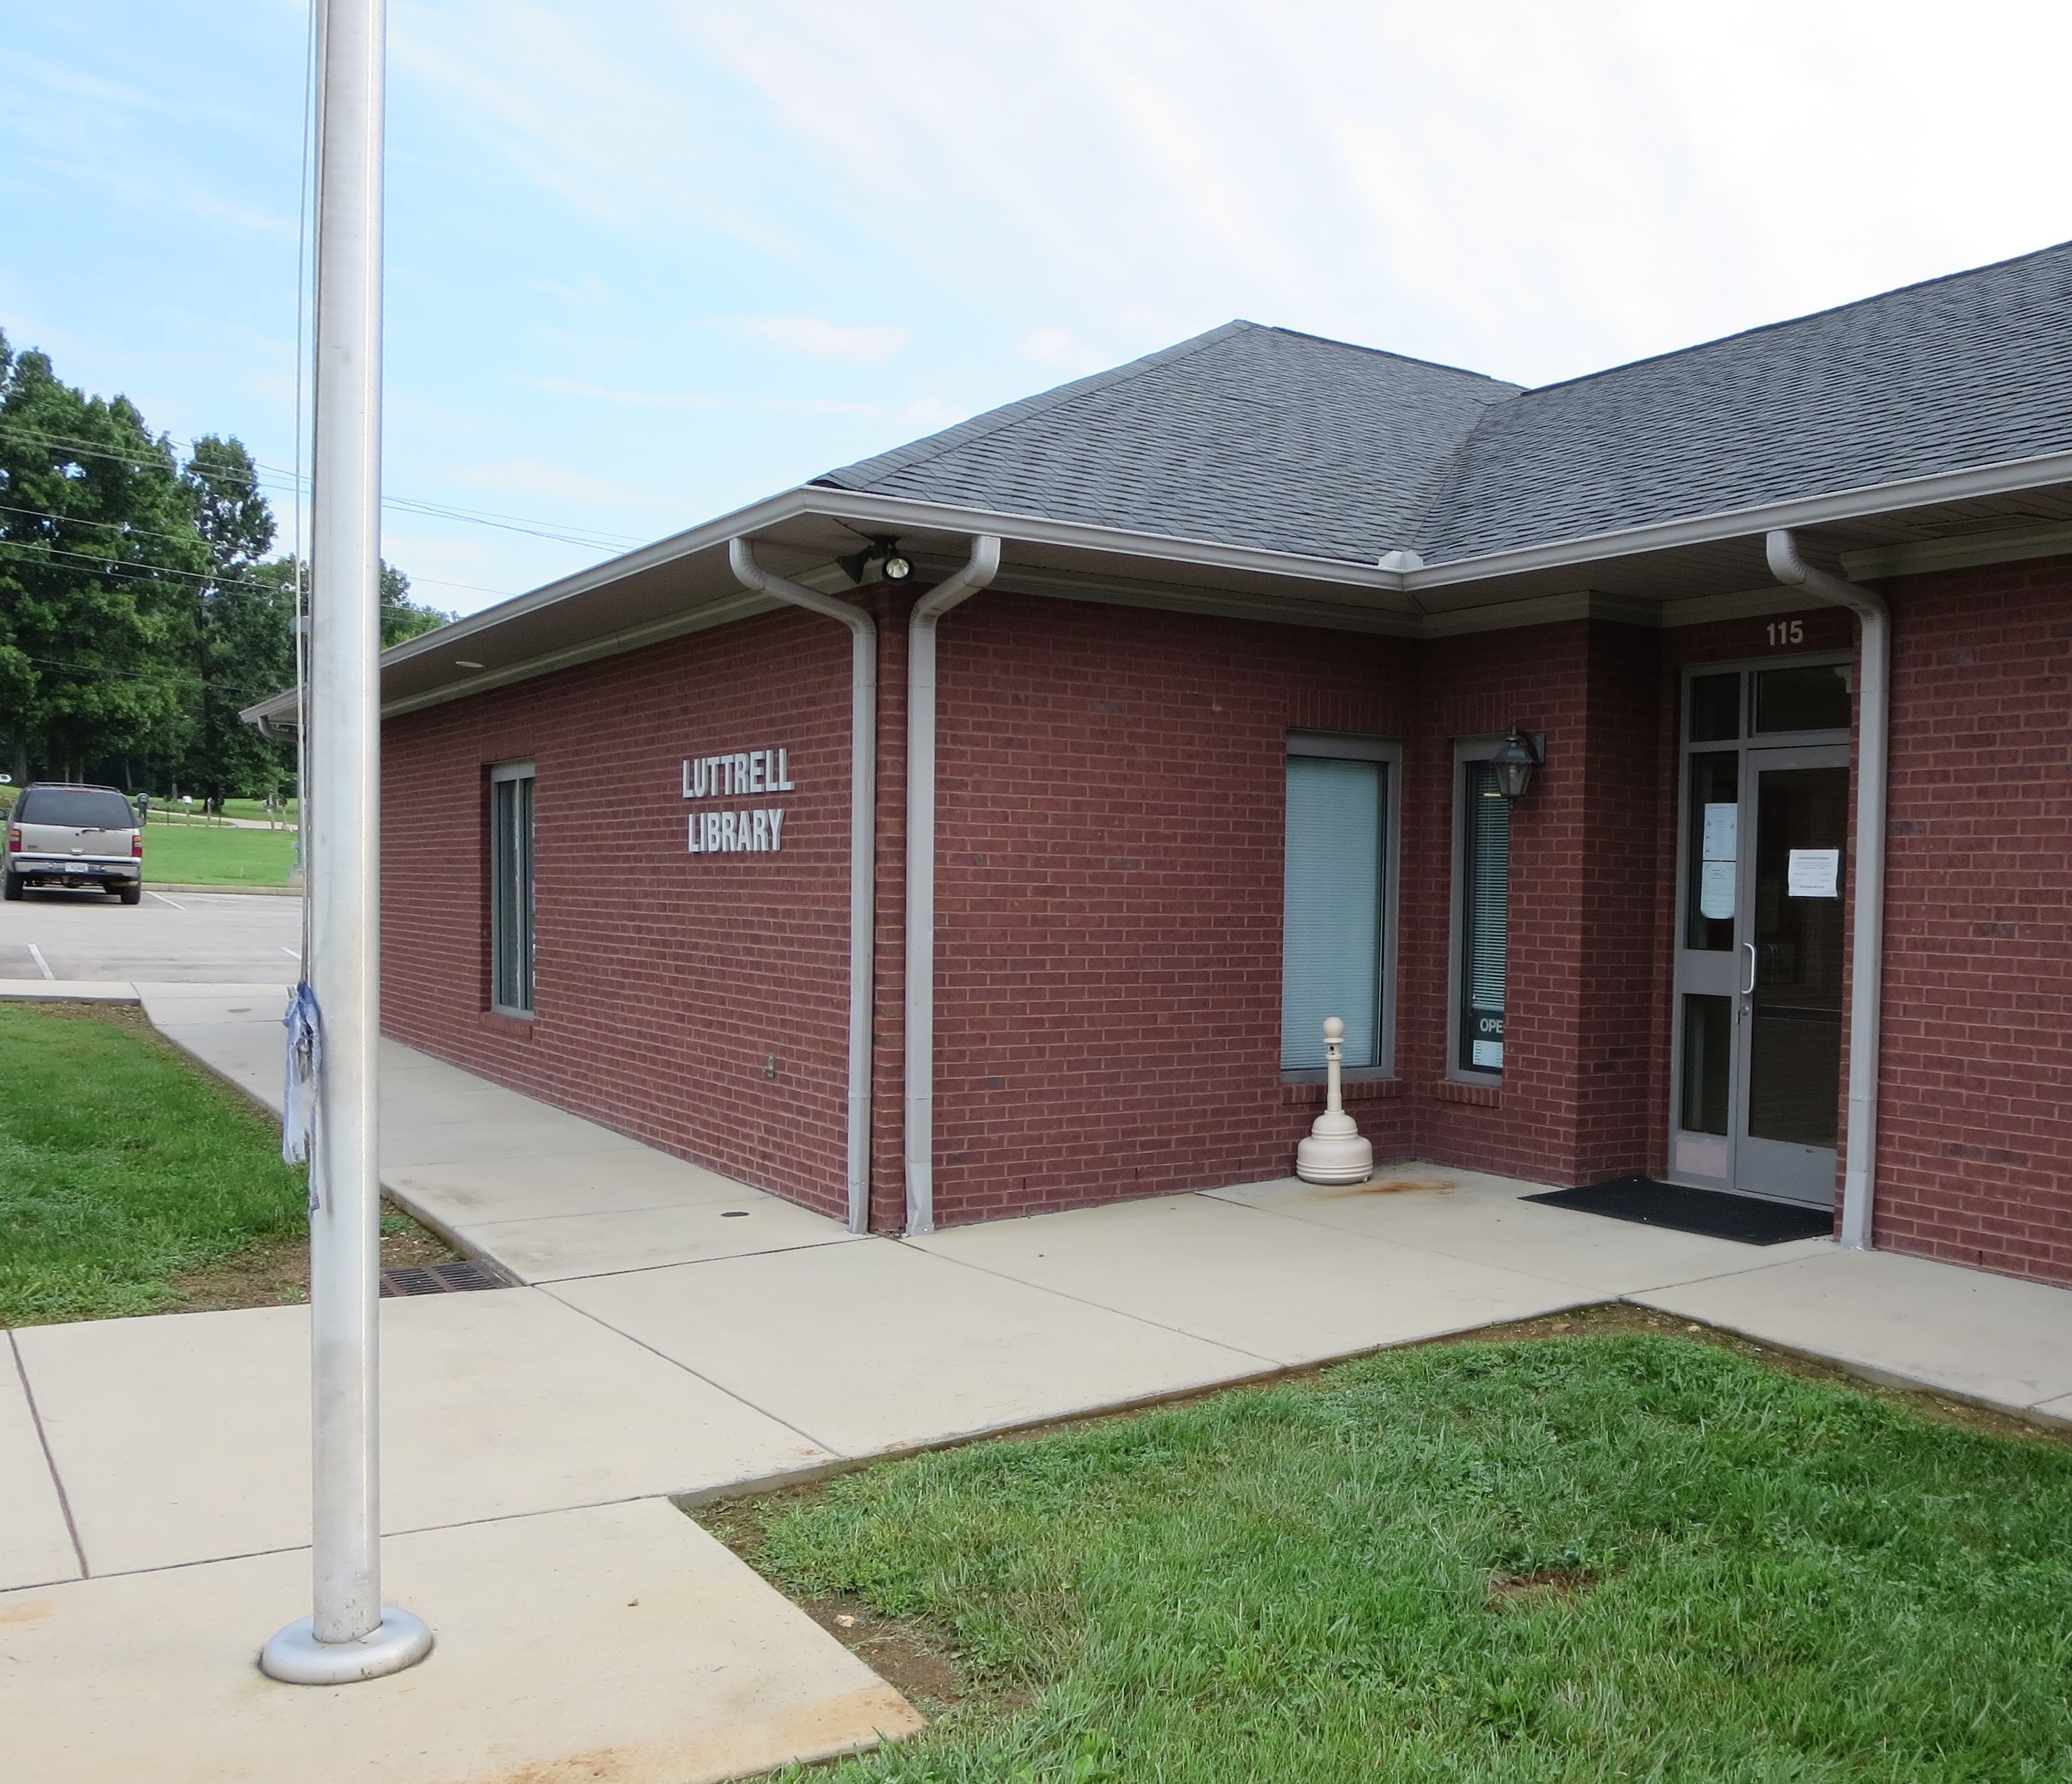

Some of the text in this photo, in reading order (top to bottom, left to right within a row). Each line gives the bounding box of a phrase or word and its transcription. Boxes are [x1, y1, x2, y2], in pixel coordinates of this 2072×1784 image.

[1767, 620, 1803, 646] 115
[682, 748, 795, 798] LUTTRELL
[688, 808, 785, 852] LIBRARY
[1479, 1017, 1504, 1034] OPE
